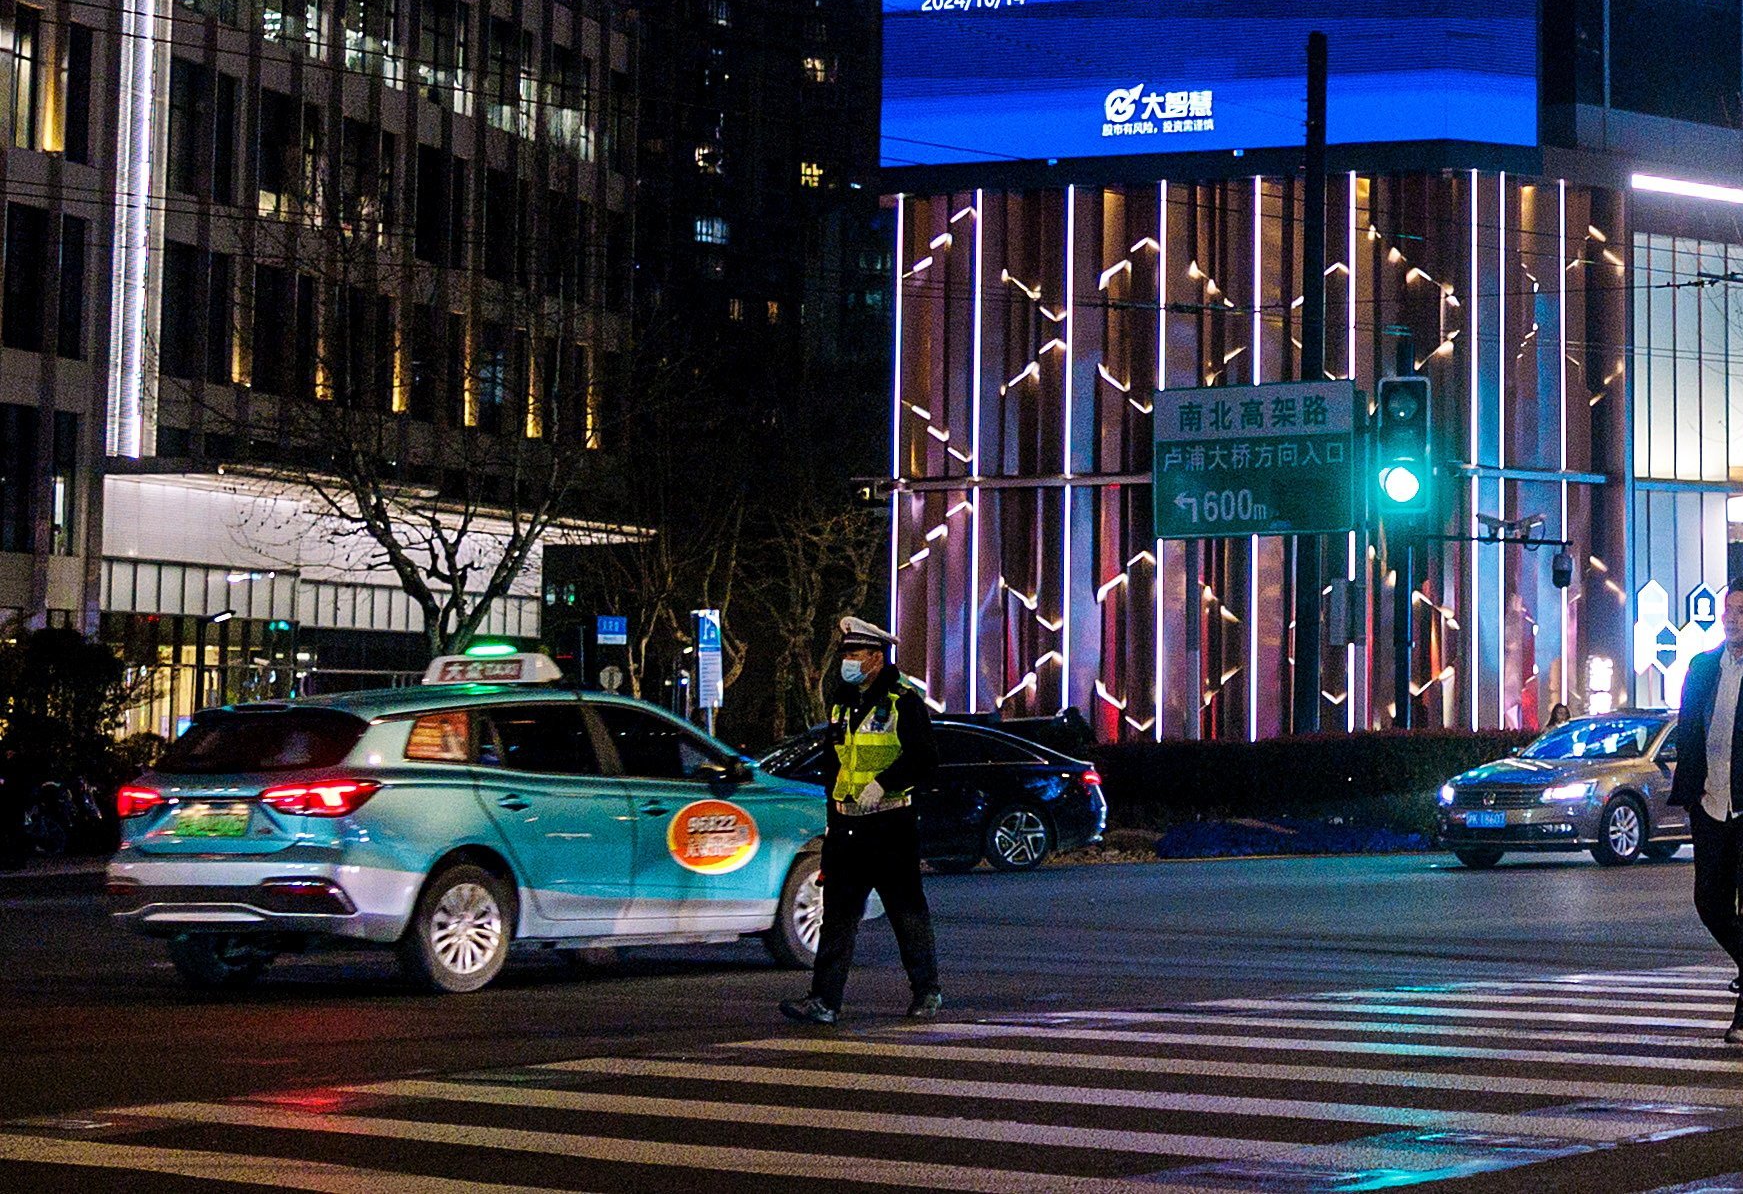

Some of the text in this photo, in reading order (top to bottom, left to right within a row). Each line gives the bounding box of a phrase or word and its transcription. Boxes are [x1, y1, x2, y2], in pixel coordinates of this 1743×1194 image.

[1140, 90, 1213, 120] 大智慧
[1178, 394, 1329, 433] 南北高架路
[1163, 440, 1345, 473] 卢浦大桥方向入口
[1203, 488, 1267, 523] 600m
